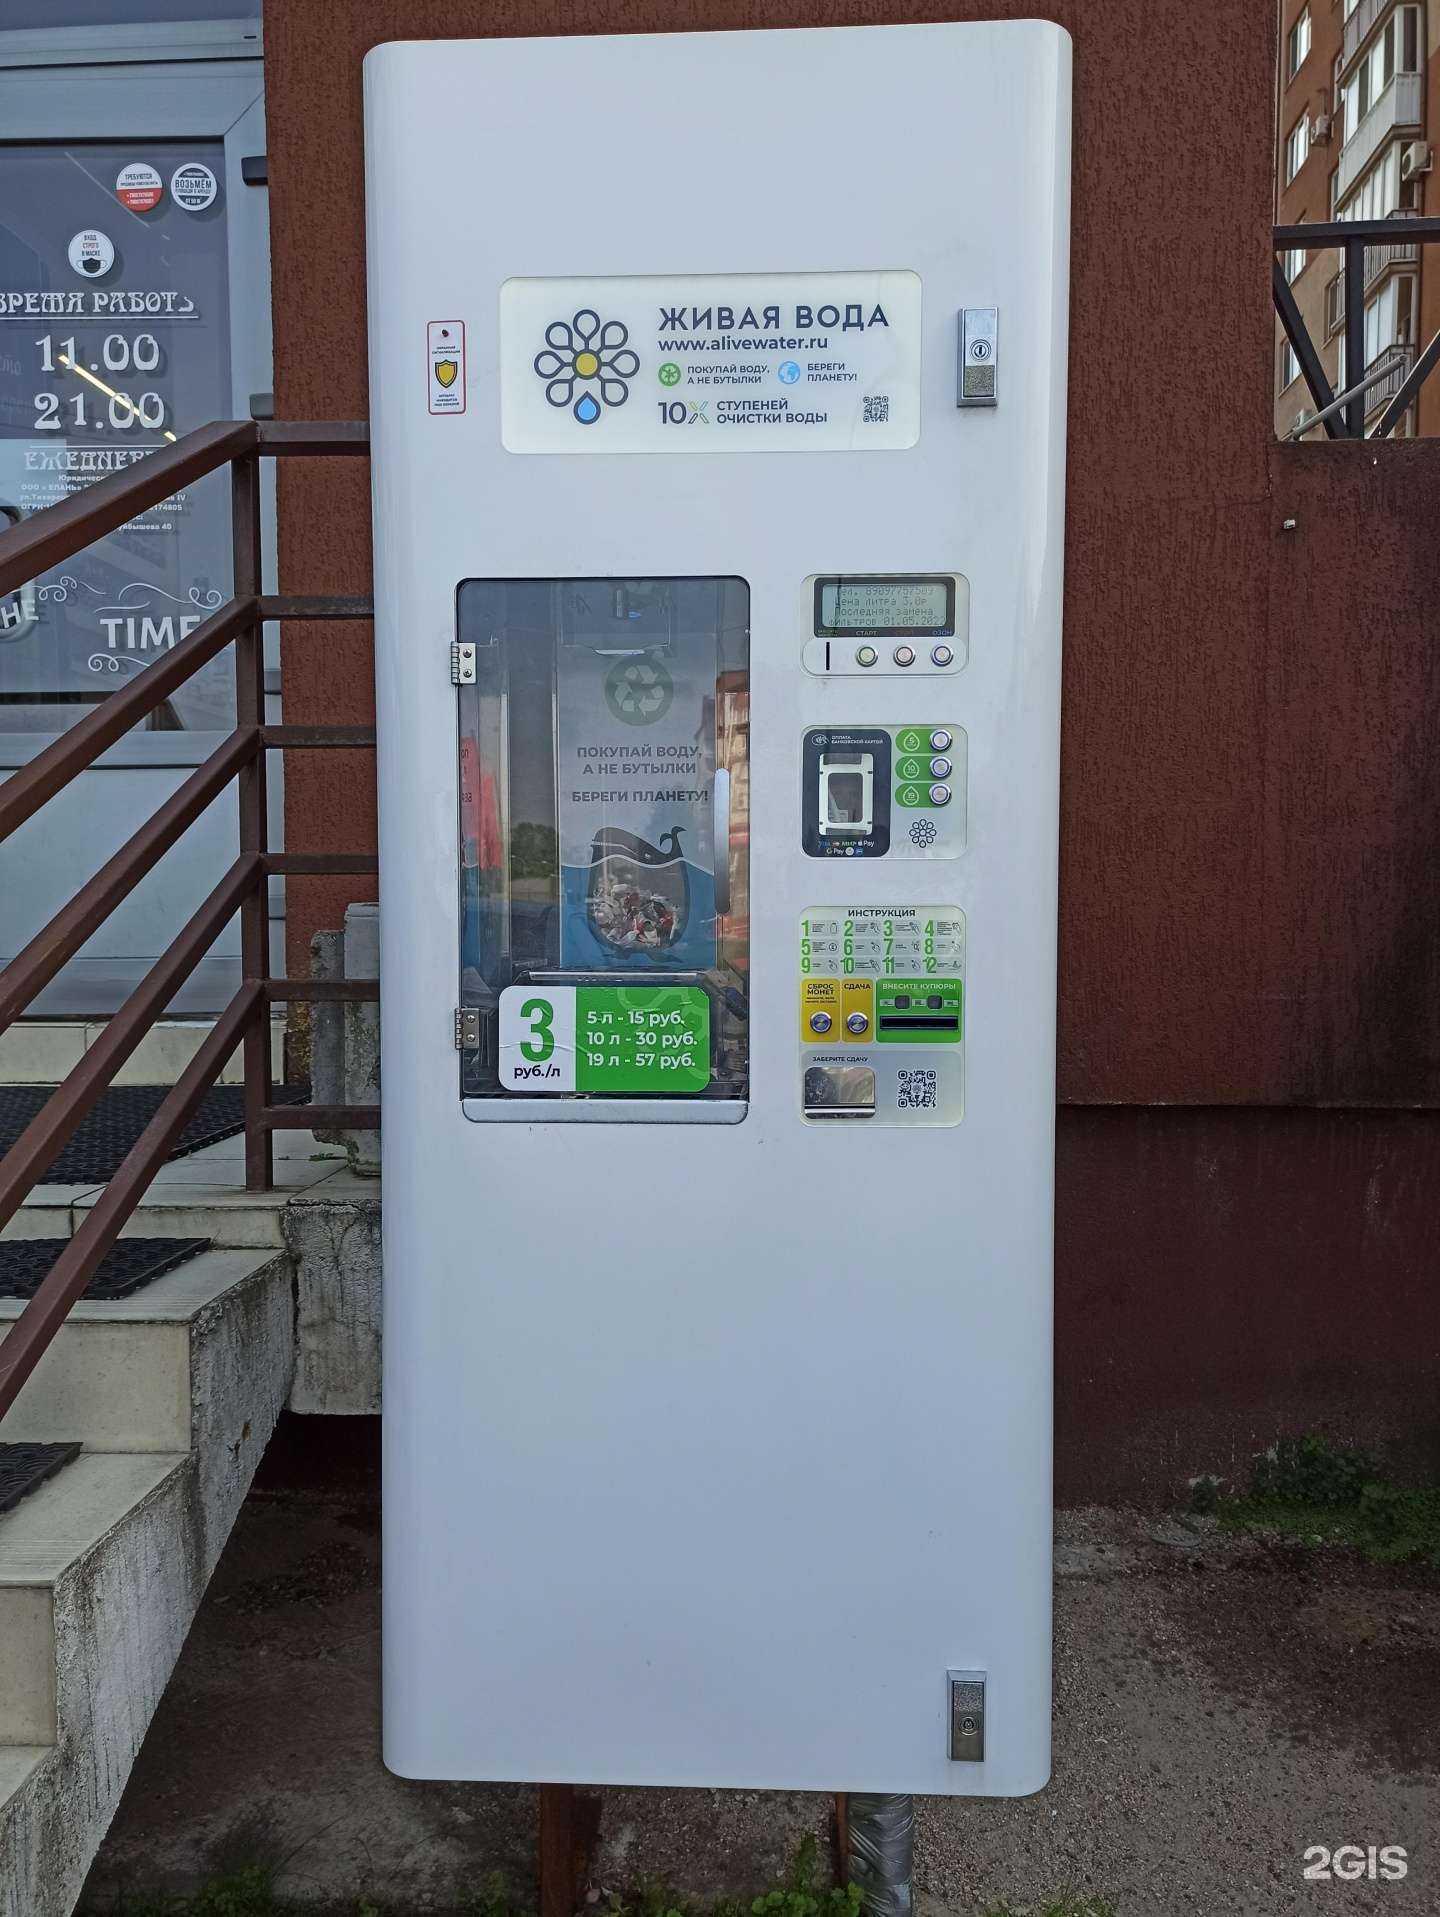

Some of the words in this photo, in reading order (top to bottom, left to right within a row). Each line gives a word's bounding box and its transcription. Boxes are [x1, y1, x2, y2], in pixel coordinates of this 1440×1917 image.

[658, 305, 780, 331] ЖИВАЯ
[795, 303, 889, 332] ВОДА
[658, 336, 828, 352] www.alivewater.ru
[35, 334, 161, 372] 11.00
[687, 364, 737, 374] ПОКУПАЙ
[739, 365, 770, 374] ВОДУ,
[807, 363, 845, 371] БЕРЕГИ
[687, 376, 695, 385] А
[697, 376, 711, 385] НЕ
[713, 376, 762, 384] БУТЫЛКИ
[807, 373, 857, 382] ПЛАНЕТУ!
[34, 392, 165, 429] 21.00
[716, 398, 788, 411] СТУПЕНЕЙ
[716, 413, 784, 424] ОЧИСТКИ
[785, 412, 828, 424] ВОДЫ
[577, 744, 652, 758] ПОКУПАЙ
[656, 746, 703, 759] ВОДУ,
[582, 764, 594, 775] А
[598, 763, 618, 774] НЕ
[622, 763, 696, 774] БУТЫЛКИ
[572, 791, 628, 802] БЕРЕГИ
[632, 790, 708, 801] ПЛАНЕТУ!
[848, 909, 916, 918] ИНСТРУКЦИЯ
[801, 920, 809, 937] 1
[844, 920, 853, 937] 2
[883, 920, 893, 937] 3
[925, 920, 934, 937] 4
[801, 939, 811, 956] 5
[844, 938, 853, 956] 6
[883, 938, 894, 955] 7
[925, 938, 934, 955] 8
[801, 956, 811, 973] 9
[840, 957, 855, 974] 10
[882, 956, 895, 974] 11
[922, 956, 937, 974] 12
[843, 983, 871, 991] СДАЧА
[587, 1012, 598, 1024] 5
[628, 1011, 645, 1024] 15
[649, 1011, 684, 1028] руб.
[520, 998, 555, 1062] 3
[587, 1032, 605, 1045] 10
[608, 1034, 620, 1045] л
[635, 1032, 657, 1045] 30
[661, 1031, 698, 1049] руб.
[587, 1053, 604, 1066] 19
[608, 1055, 620, 1066] л
[635, 1053, 656, 1066] 57
[660, 1052, 696, 1070] руб.
[514, 1064, 561, 1079] руб./л
